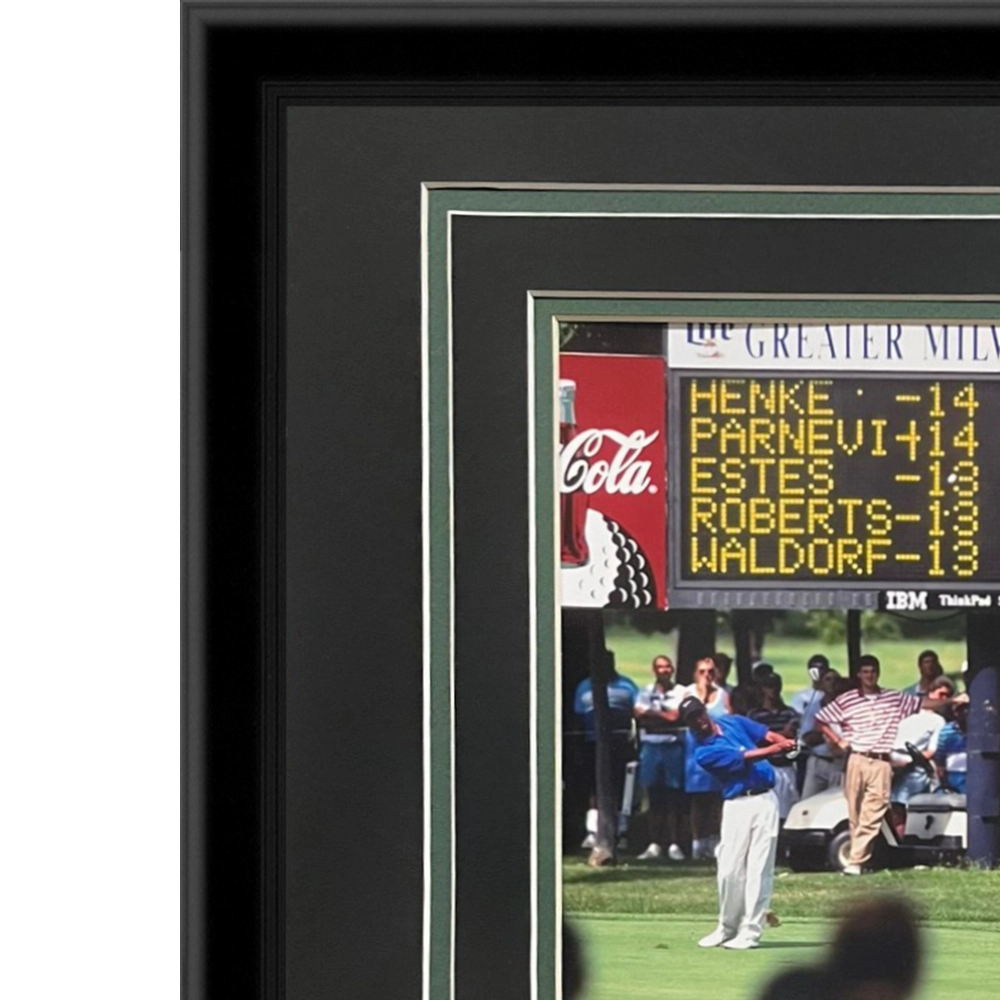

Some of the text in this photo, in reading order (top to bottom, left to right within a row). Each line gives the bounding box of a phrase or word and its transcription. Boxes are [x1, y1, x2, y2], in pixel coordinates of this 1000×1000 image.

[745, 323, 903, 360] GREATER
[691, 379, 834, 415] HENKE
[691, 458, 834, 494] ESTES
[886, 591, 928, 610] IBM
[938, 594, 992, 607] ThinkPad
